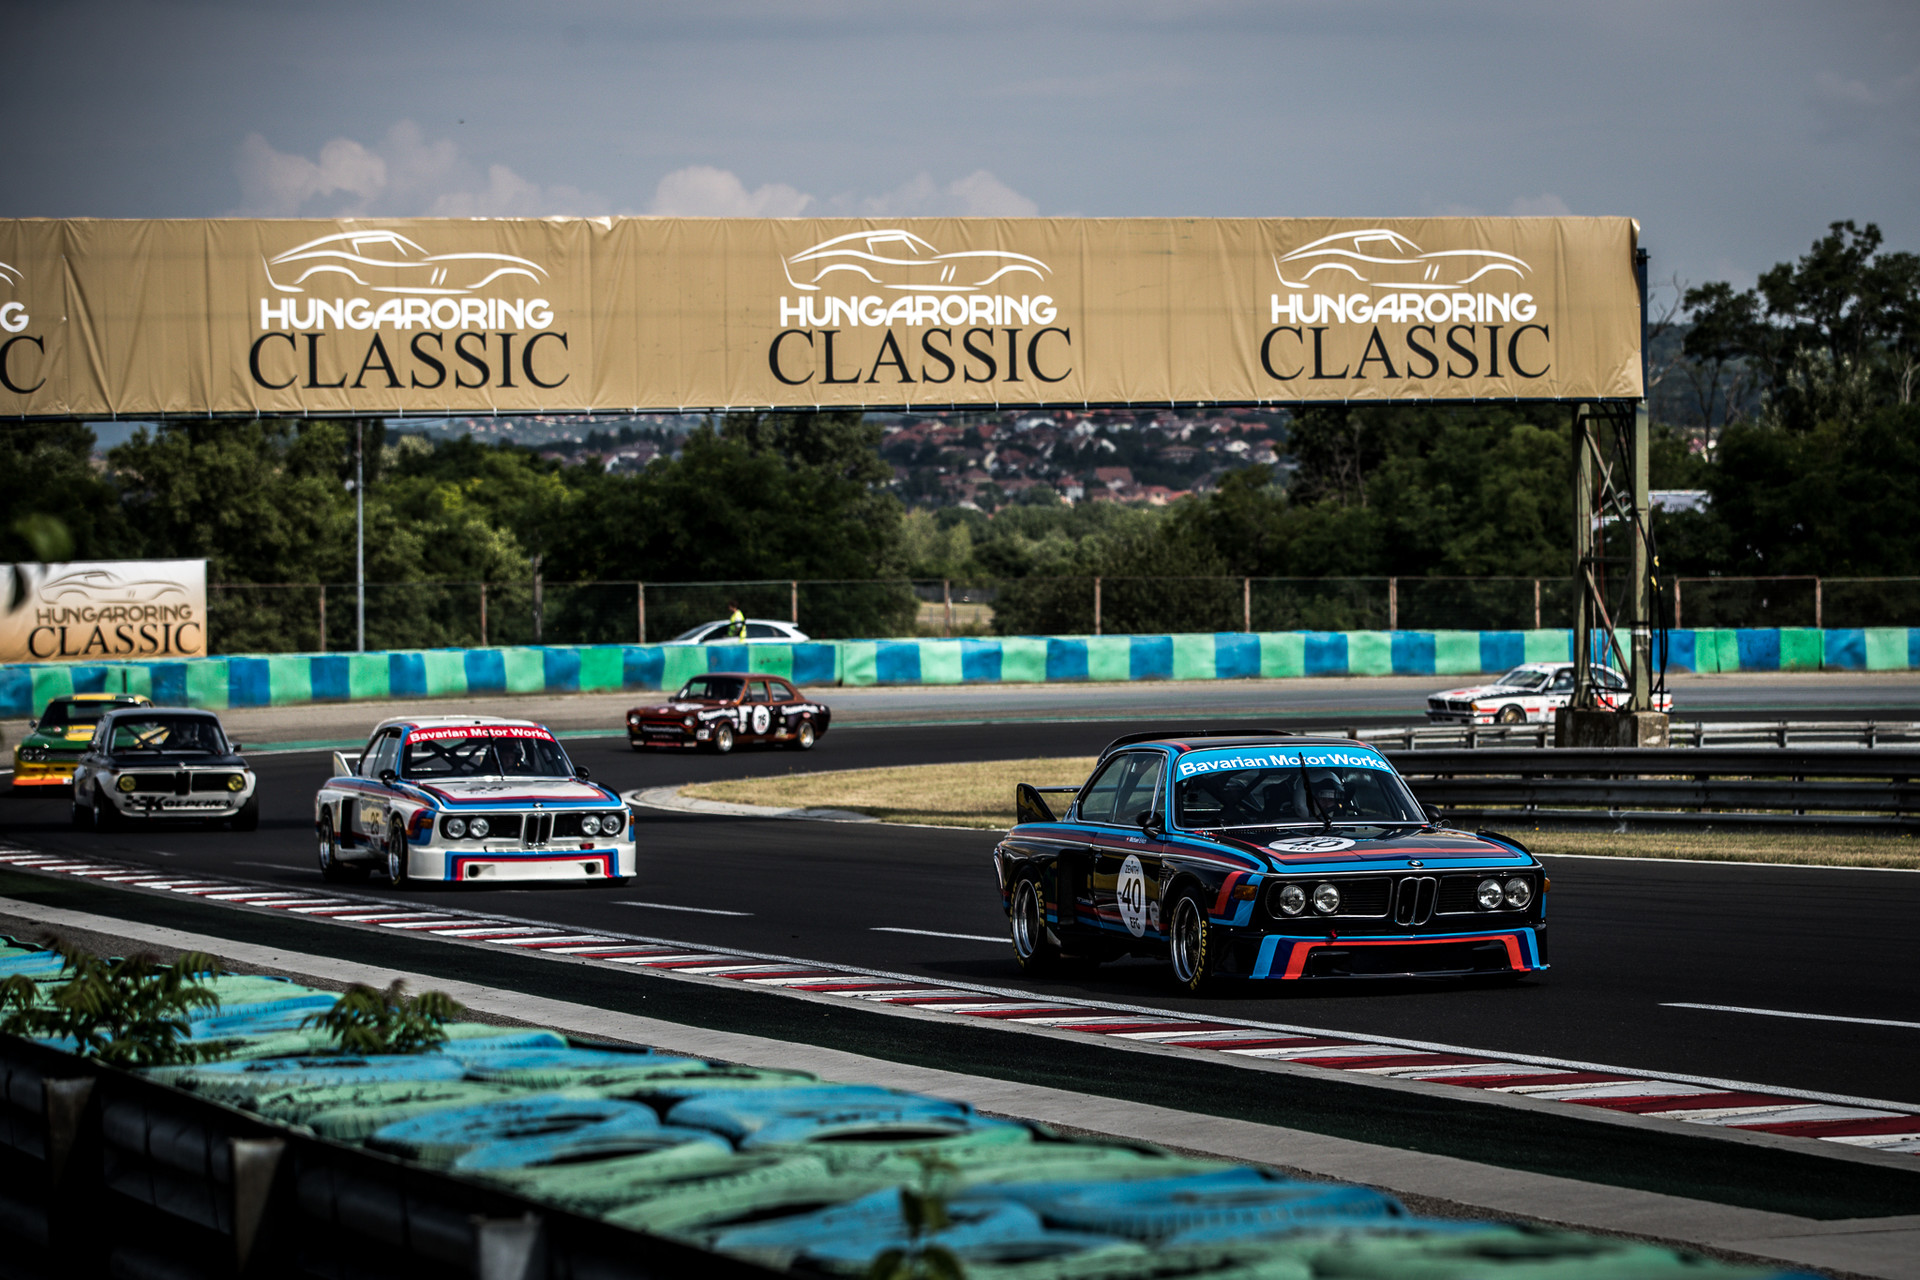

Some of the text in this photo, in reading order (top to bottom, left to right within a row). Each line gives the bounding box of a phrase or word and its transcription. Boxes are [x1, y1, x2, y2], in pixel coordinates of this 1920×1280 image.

[260, 297, 554, 331] HUNGARORING
[779, 295, 1058, 327] HUNGARORING
[1270, 292, 1538, 324] HUNGARORING
[249, 331, 570, 390] CLASSIC
[769, 326, 1072, 386] CLASSIC
[1260, 323, 1551, 381] CLASSIC
[36, 604, 193, 624] HUNGARORING
[28, 622, 200, 658] CLASSIC
[409, 728, 551, 742] Bavarian Motor Works
[1180, 756, 1268, 776] Bavarian
[1327, 753, 1389, 771] Works
[1034, 881, 1046, 927] EAGLE
[1122, 877, 1142, 914] 40
[1129, 916, 1141, 930] EFG
